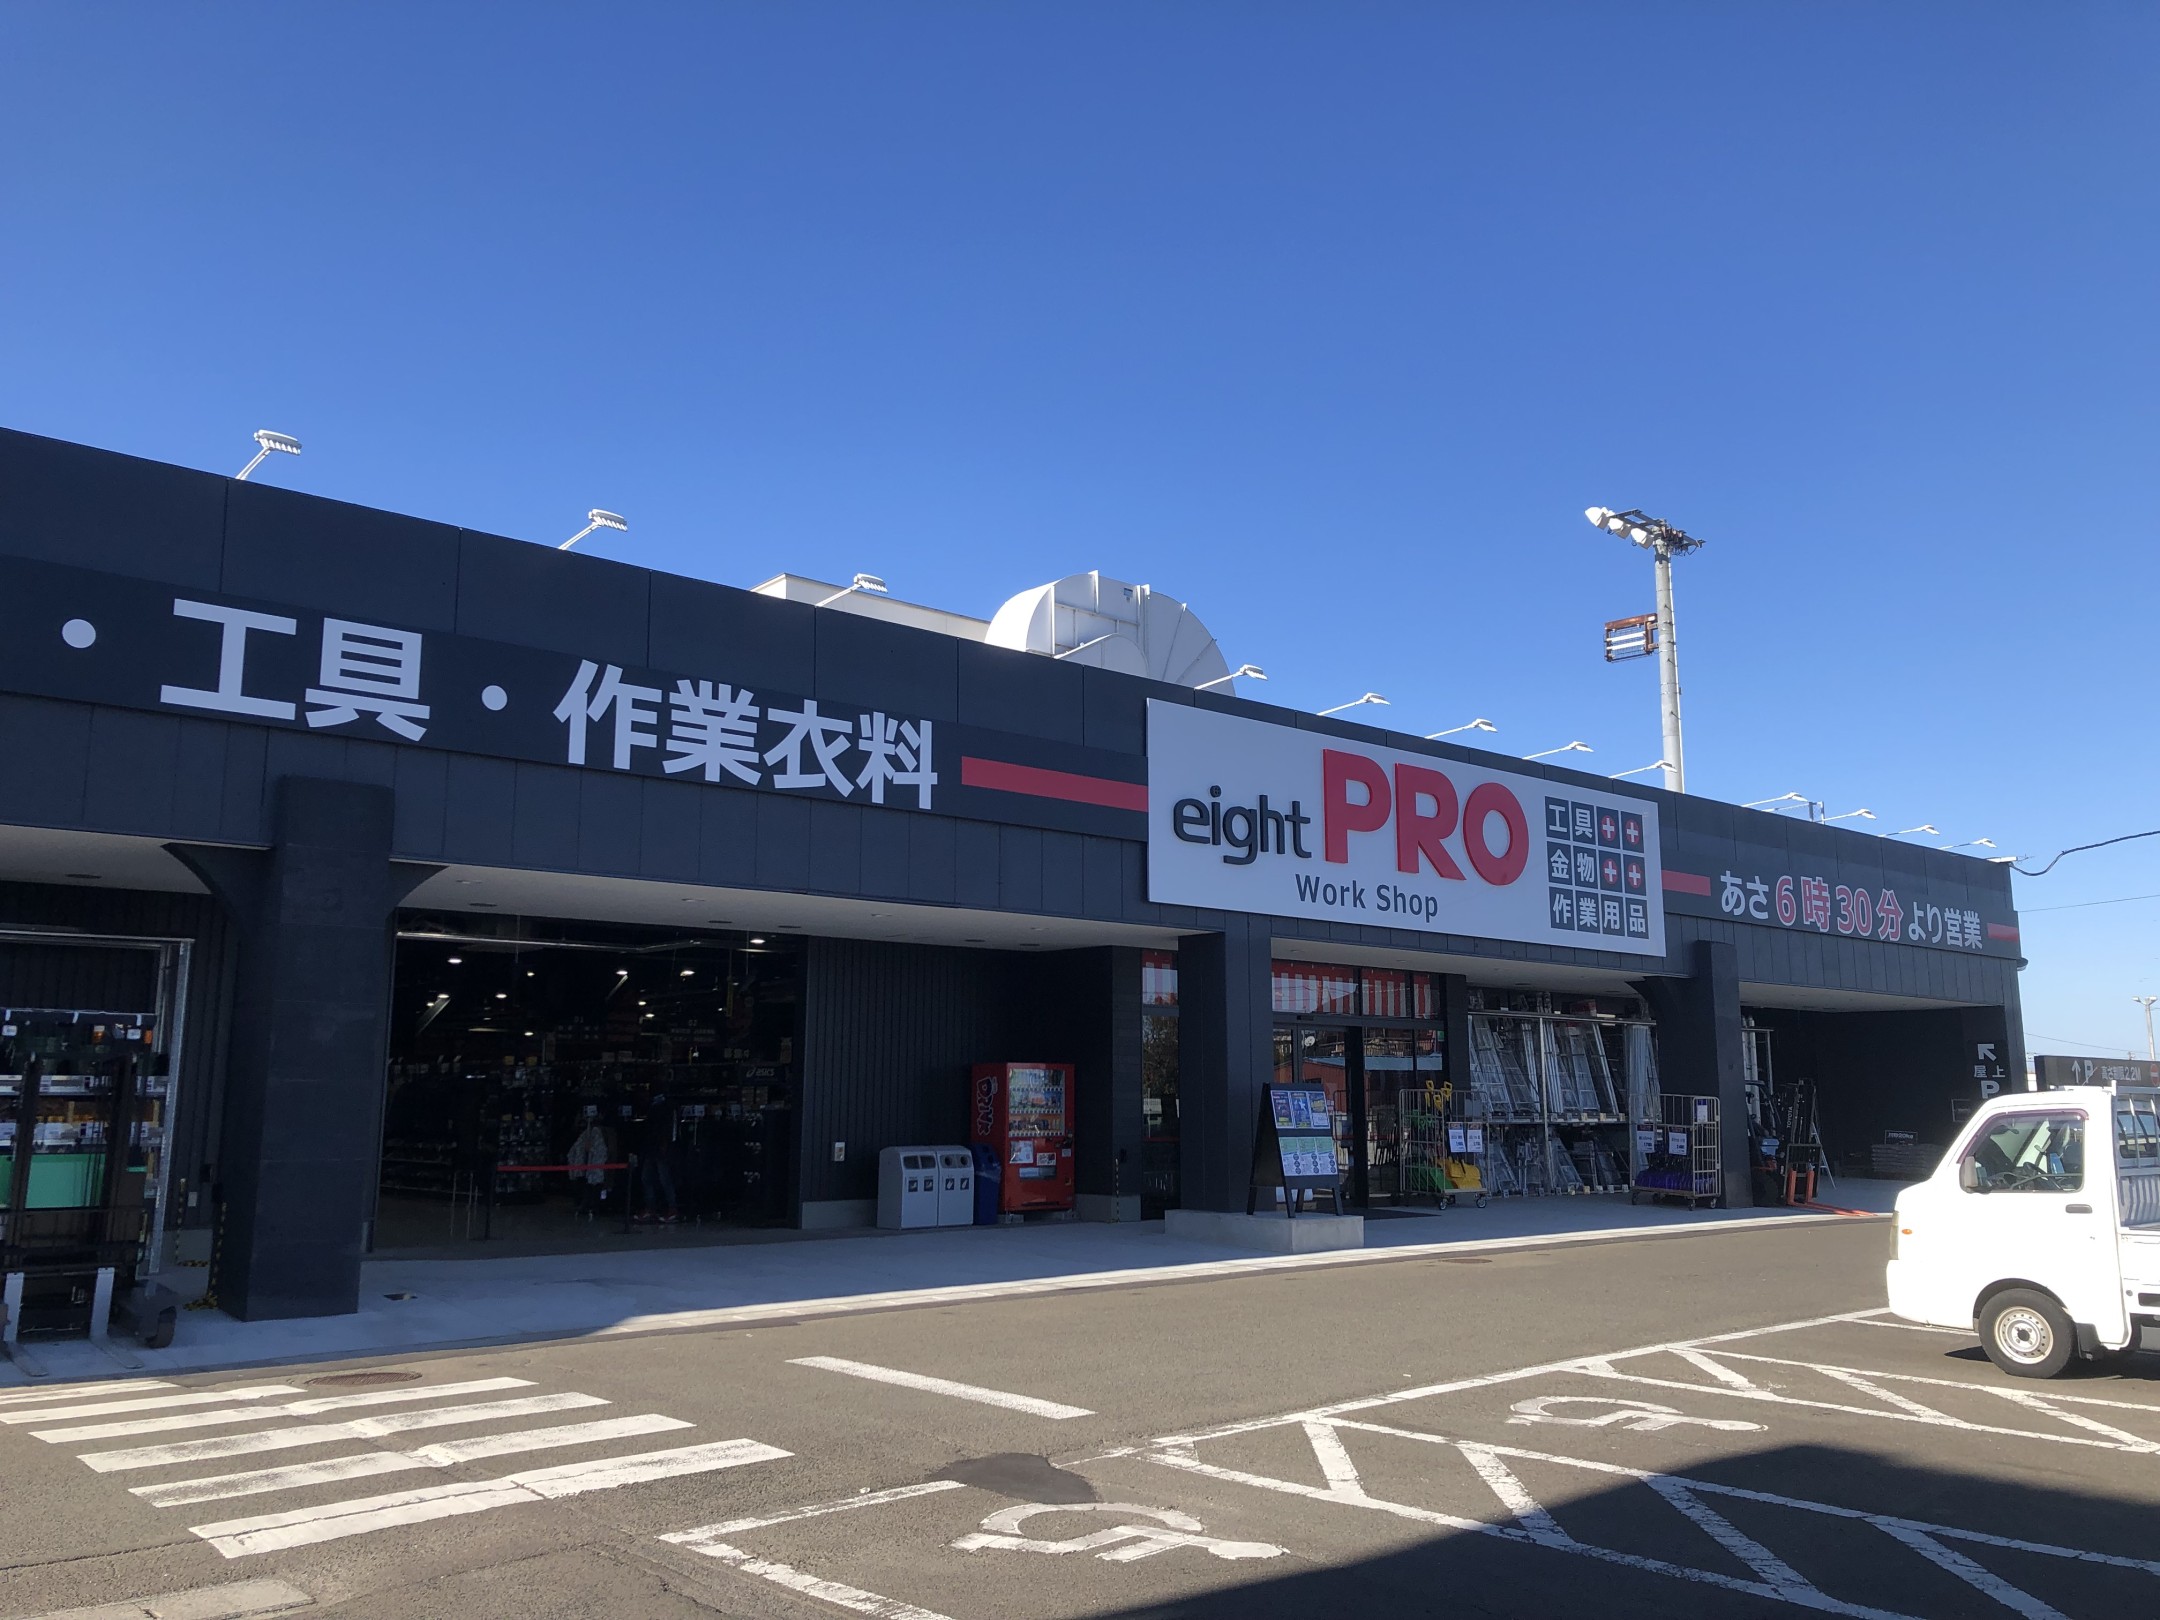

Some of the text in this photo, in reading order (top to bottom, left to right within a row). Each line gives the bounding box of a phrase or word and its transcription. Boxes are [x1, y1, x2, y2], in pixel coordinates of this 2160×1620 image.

[1173, 748, 1530, 886] eight PRO
[1548, 804, 1593, 838] 工具
[1550, 849, 1595, 883] 金物
[1295, 873, 1439, 923] Work Shop
[1552, 893, 1646, 933] 作業用品
[1973, 1065, 2005, 1078] 屋上
[1981, 1080, 2000, 1099] P
